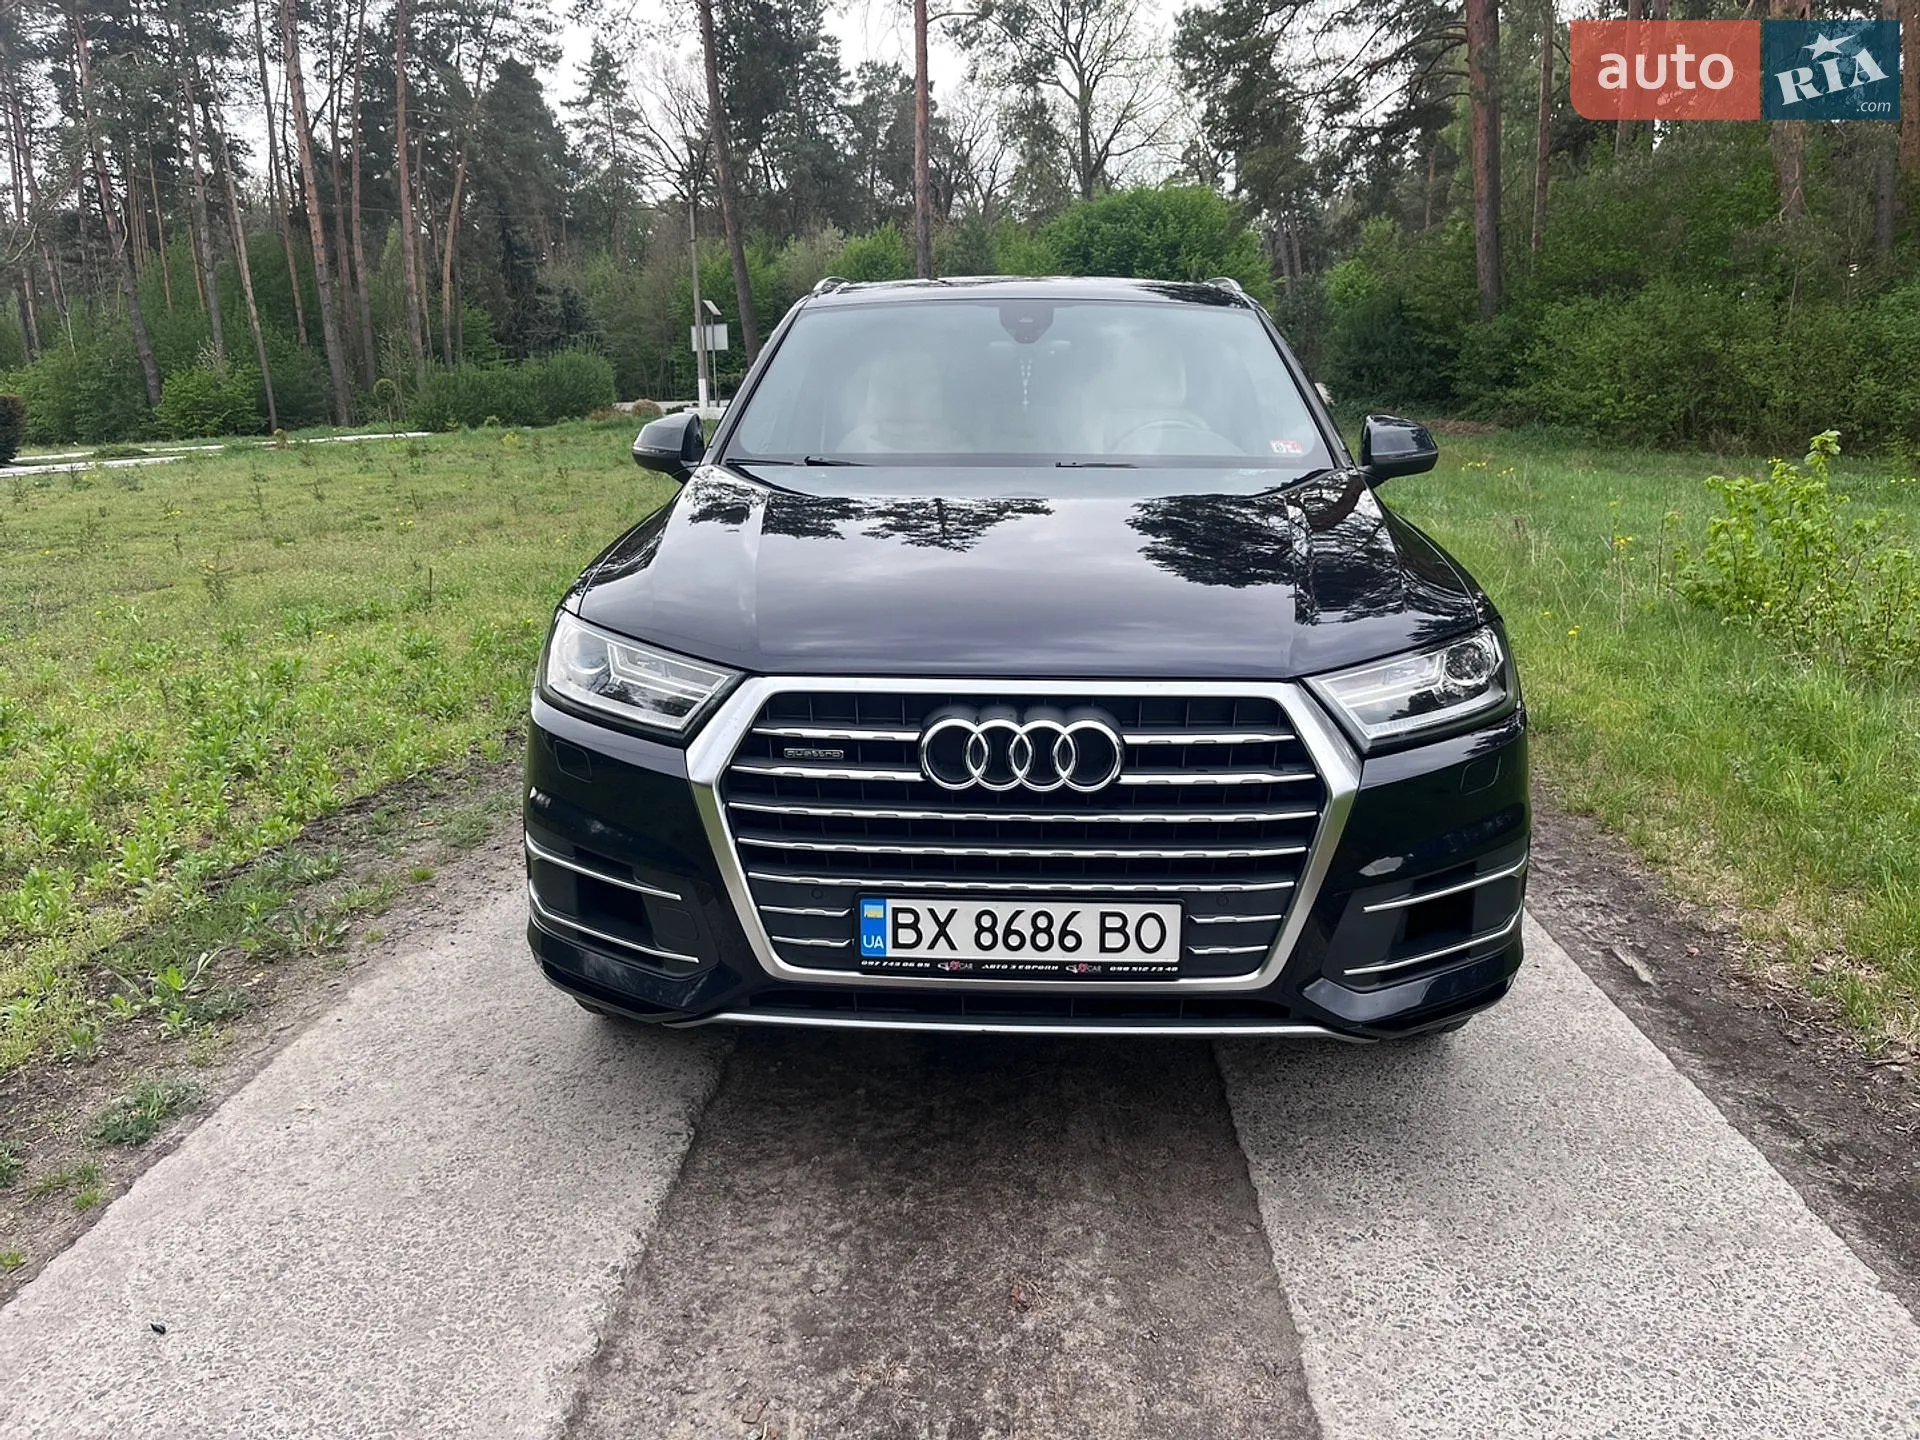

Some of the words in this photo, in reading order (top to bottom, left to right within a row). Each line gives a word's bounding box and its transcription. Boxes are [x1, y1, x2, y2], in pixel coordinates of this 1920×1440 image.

[863, 935, 884, 949] UA
[891, 906, 959, 950] BX
[973, 909, 1083, 952] 8686
[1098, 910, 1168, 954] BO
